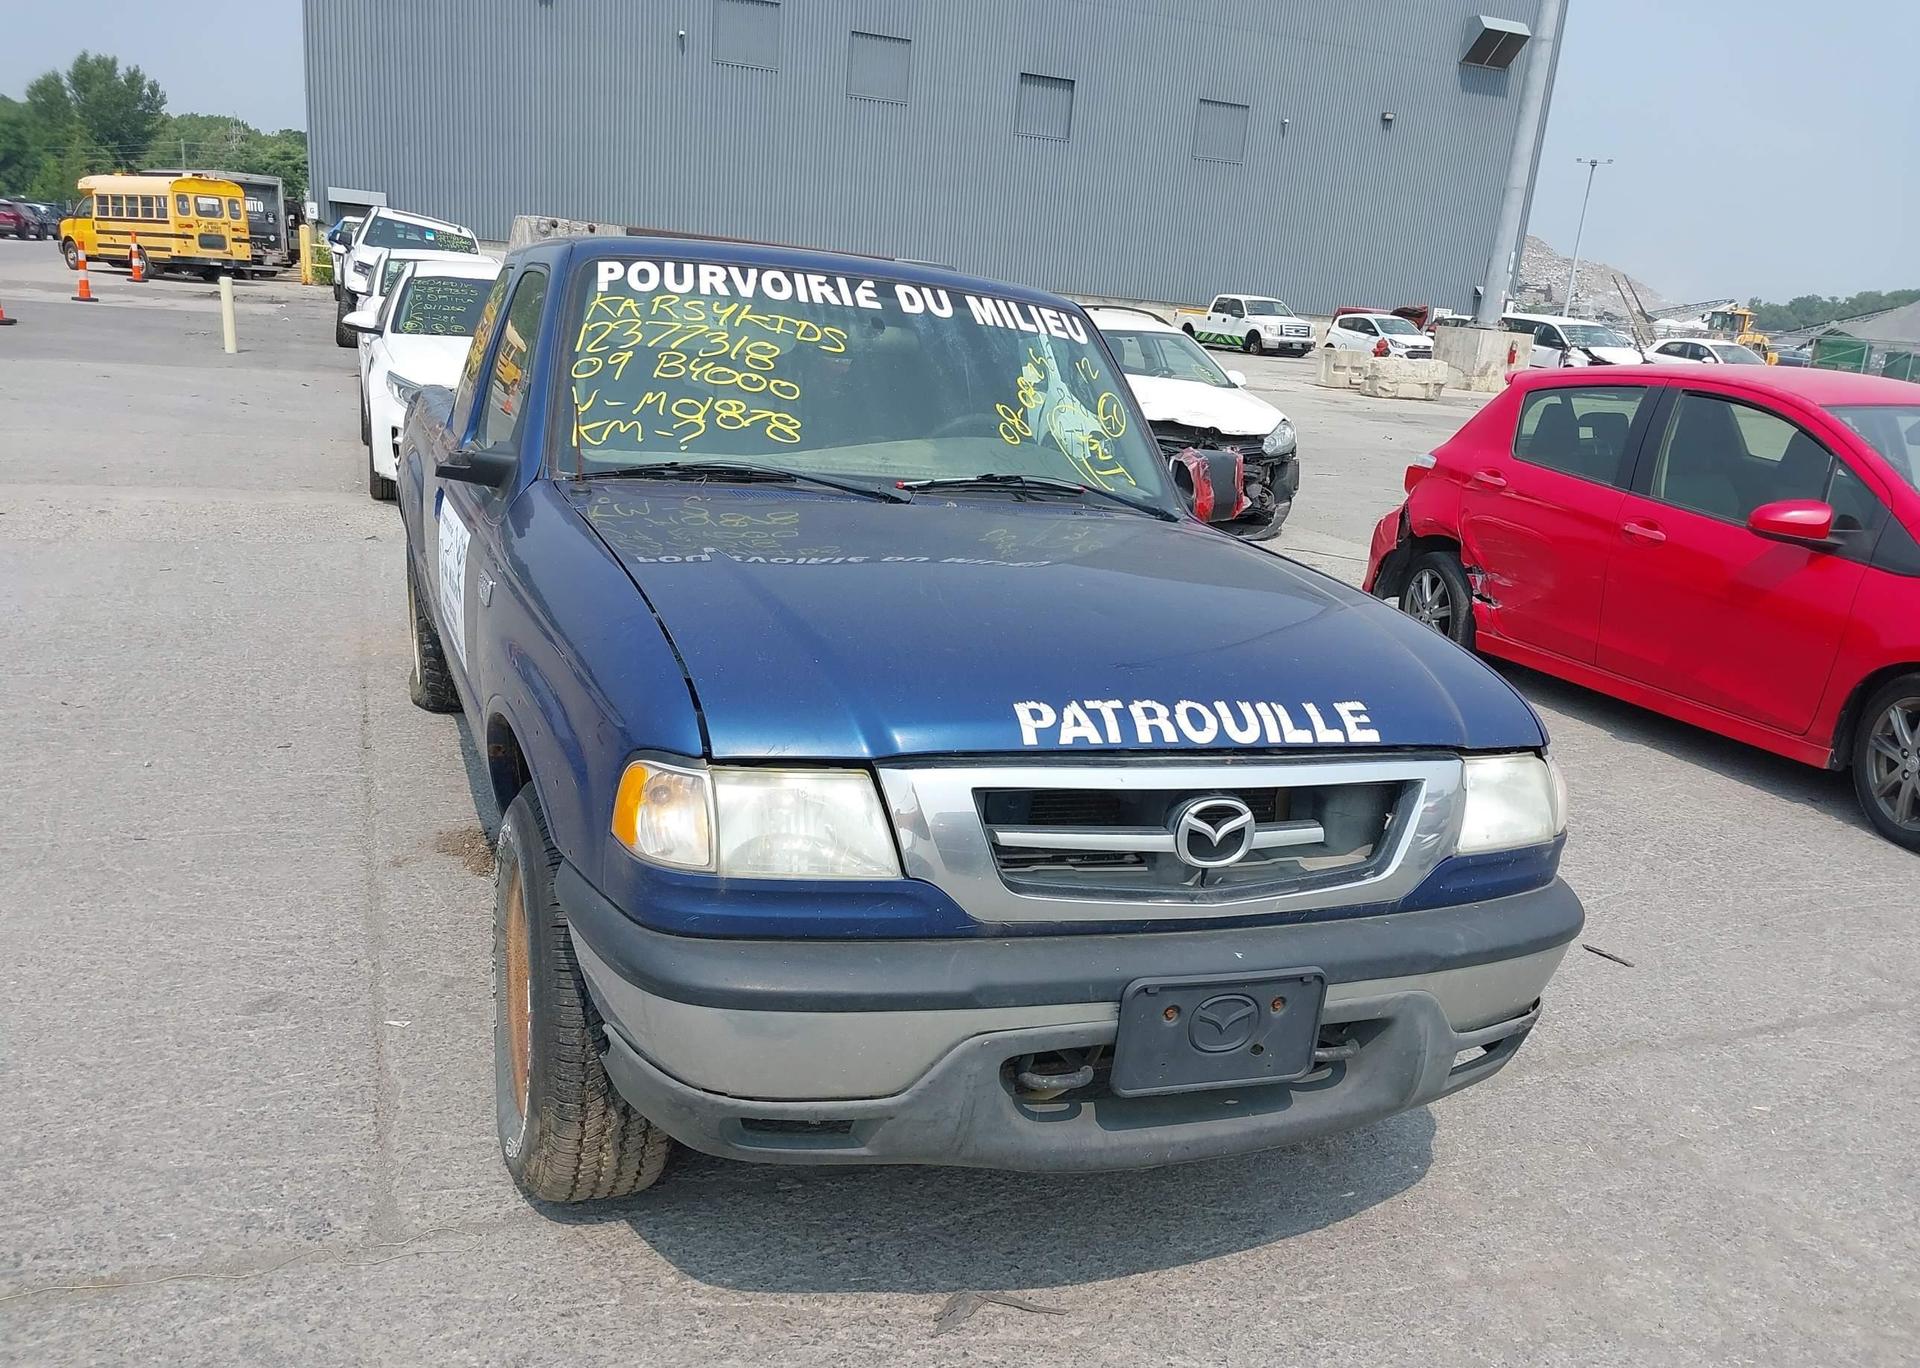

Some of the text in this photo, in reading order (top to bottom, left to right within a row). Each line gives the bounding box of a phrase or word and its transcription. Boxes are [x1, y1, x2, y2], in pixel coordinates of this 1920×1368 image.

[894, 284, 954, 318] DU
[964, 295, 1089, 345] MILIEU
[575, 319, 781, 370] 12377318
[571, 351, 801, 400] 09 B4000
[1012, 699, 1382, 746] PATROUILLE
